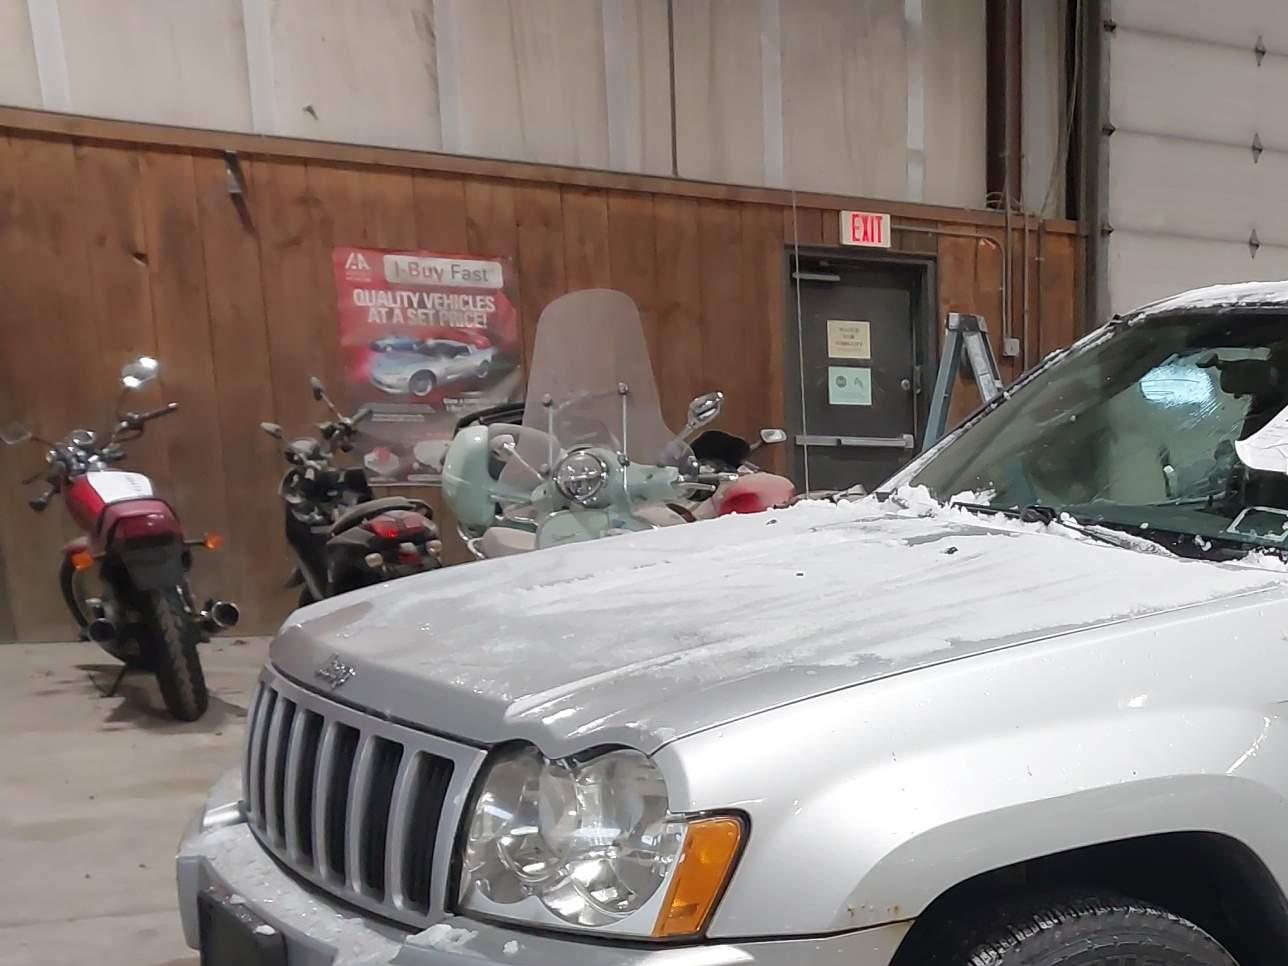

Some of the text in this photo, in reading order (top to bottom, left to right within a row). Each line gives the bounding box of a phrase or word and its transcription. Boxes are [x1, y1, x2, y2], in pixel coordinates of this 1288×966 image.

[850, 213, 883, 243] EXIT
[393, 260, 444, 282] I-Buy
[451, 263, 489, 282] Fast
[353, 288, 496, 313] QUALITY VEHICLES
[367, 307, 488, 329] AT A SET PRICE!
